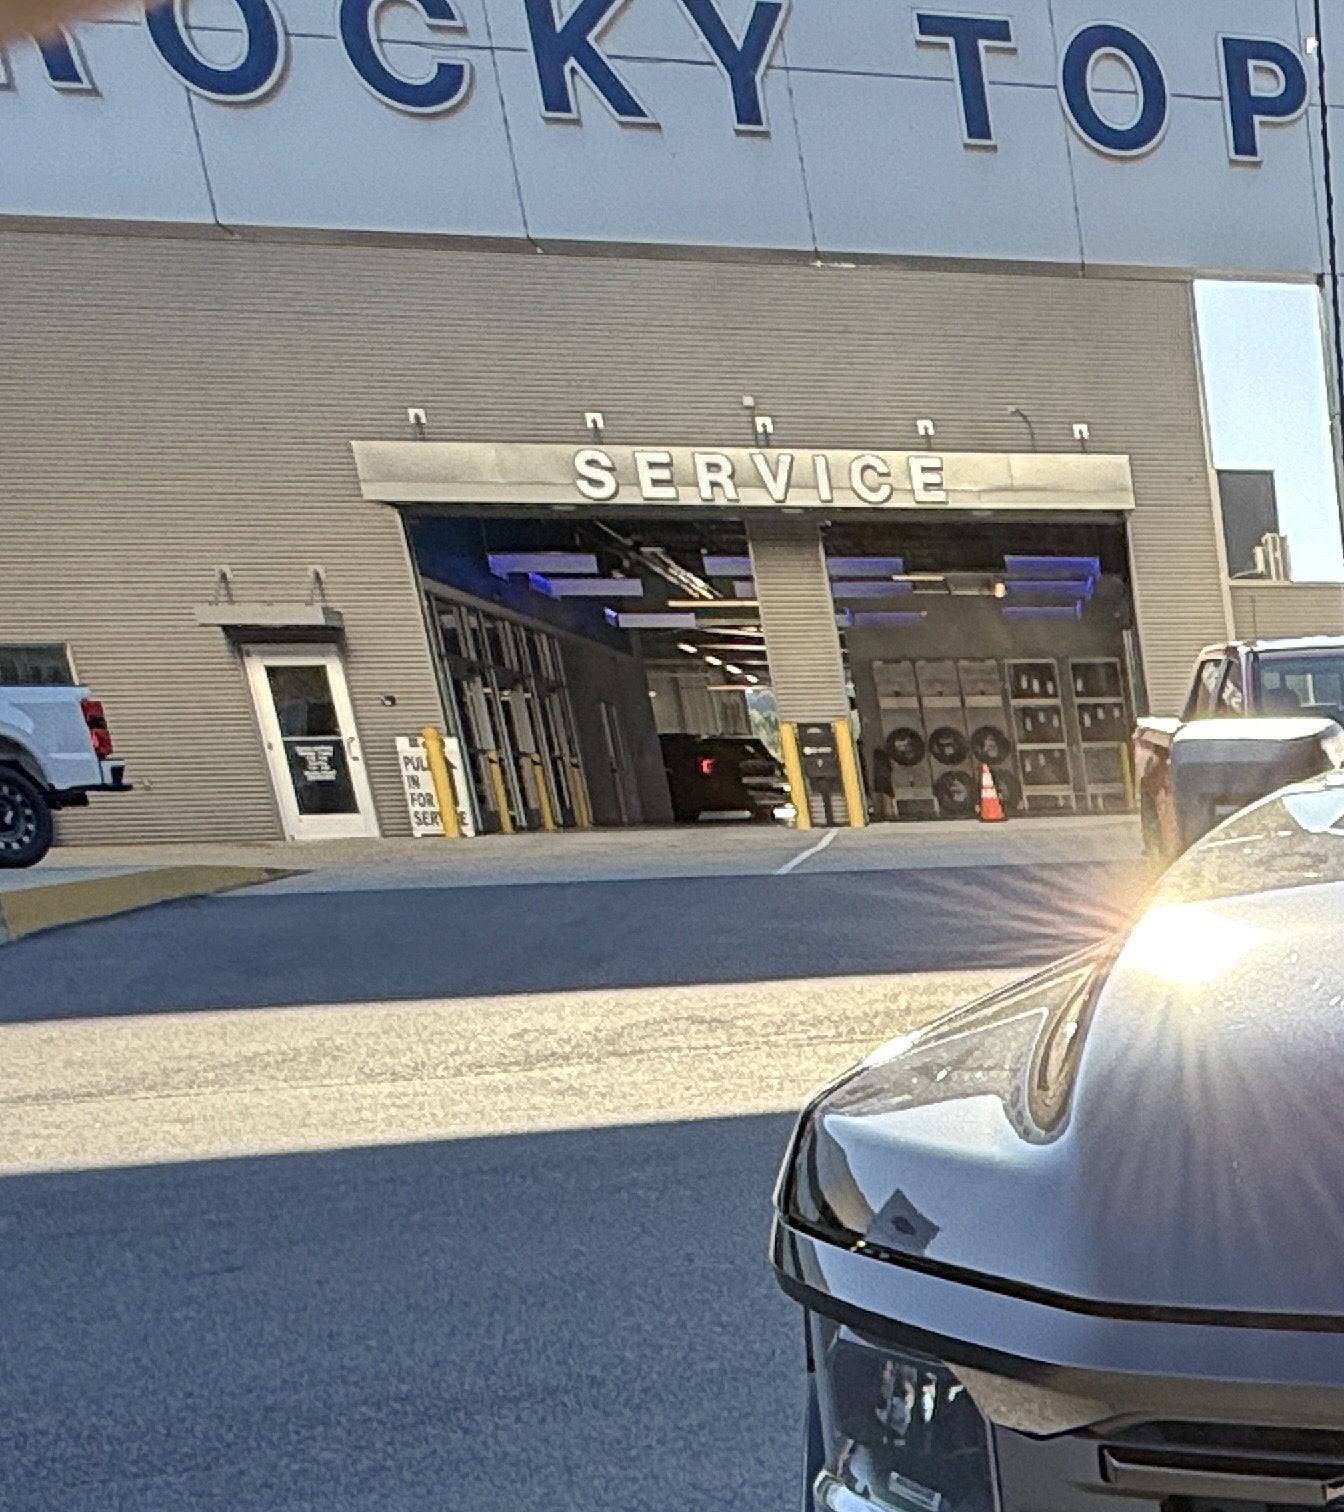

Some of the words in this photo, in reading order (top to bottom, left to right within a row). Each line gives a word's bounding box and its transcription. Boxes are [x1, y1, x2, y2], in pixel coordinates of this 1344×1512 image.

[0, 0, 786, 134] OCKY
[912, 10, 1309, 163] TOP
[574, 449, 949, 504] SERVICE
[402, 755, 432, 771] PUL
[406, 775, 420, 789] IN
[409, 793, 435, 807] FOR
[413, 811, 469, 826] SERE
